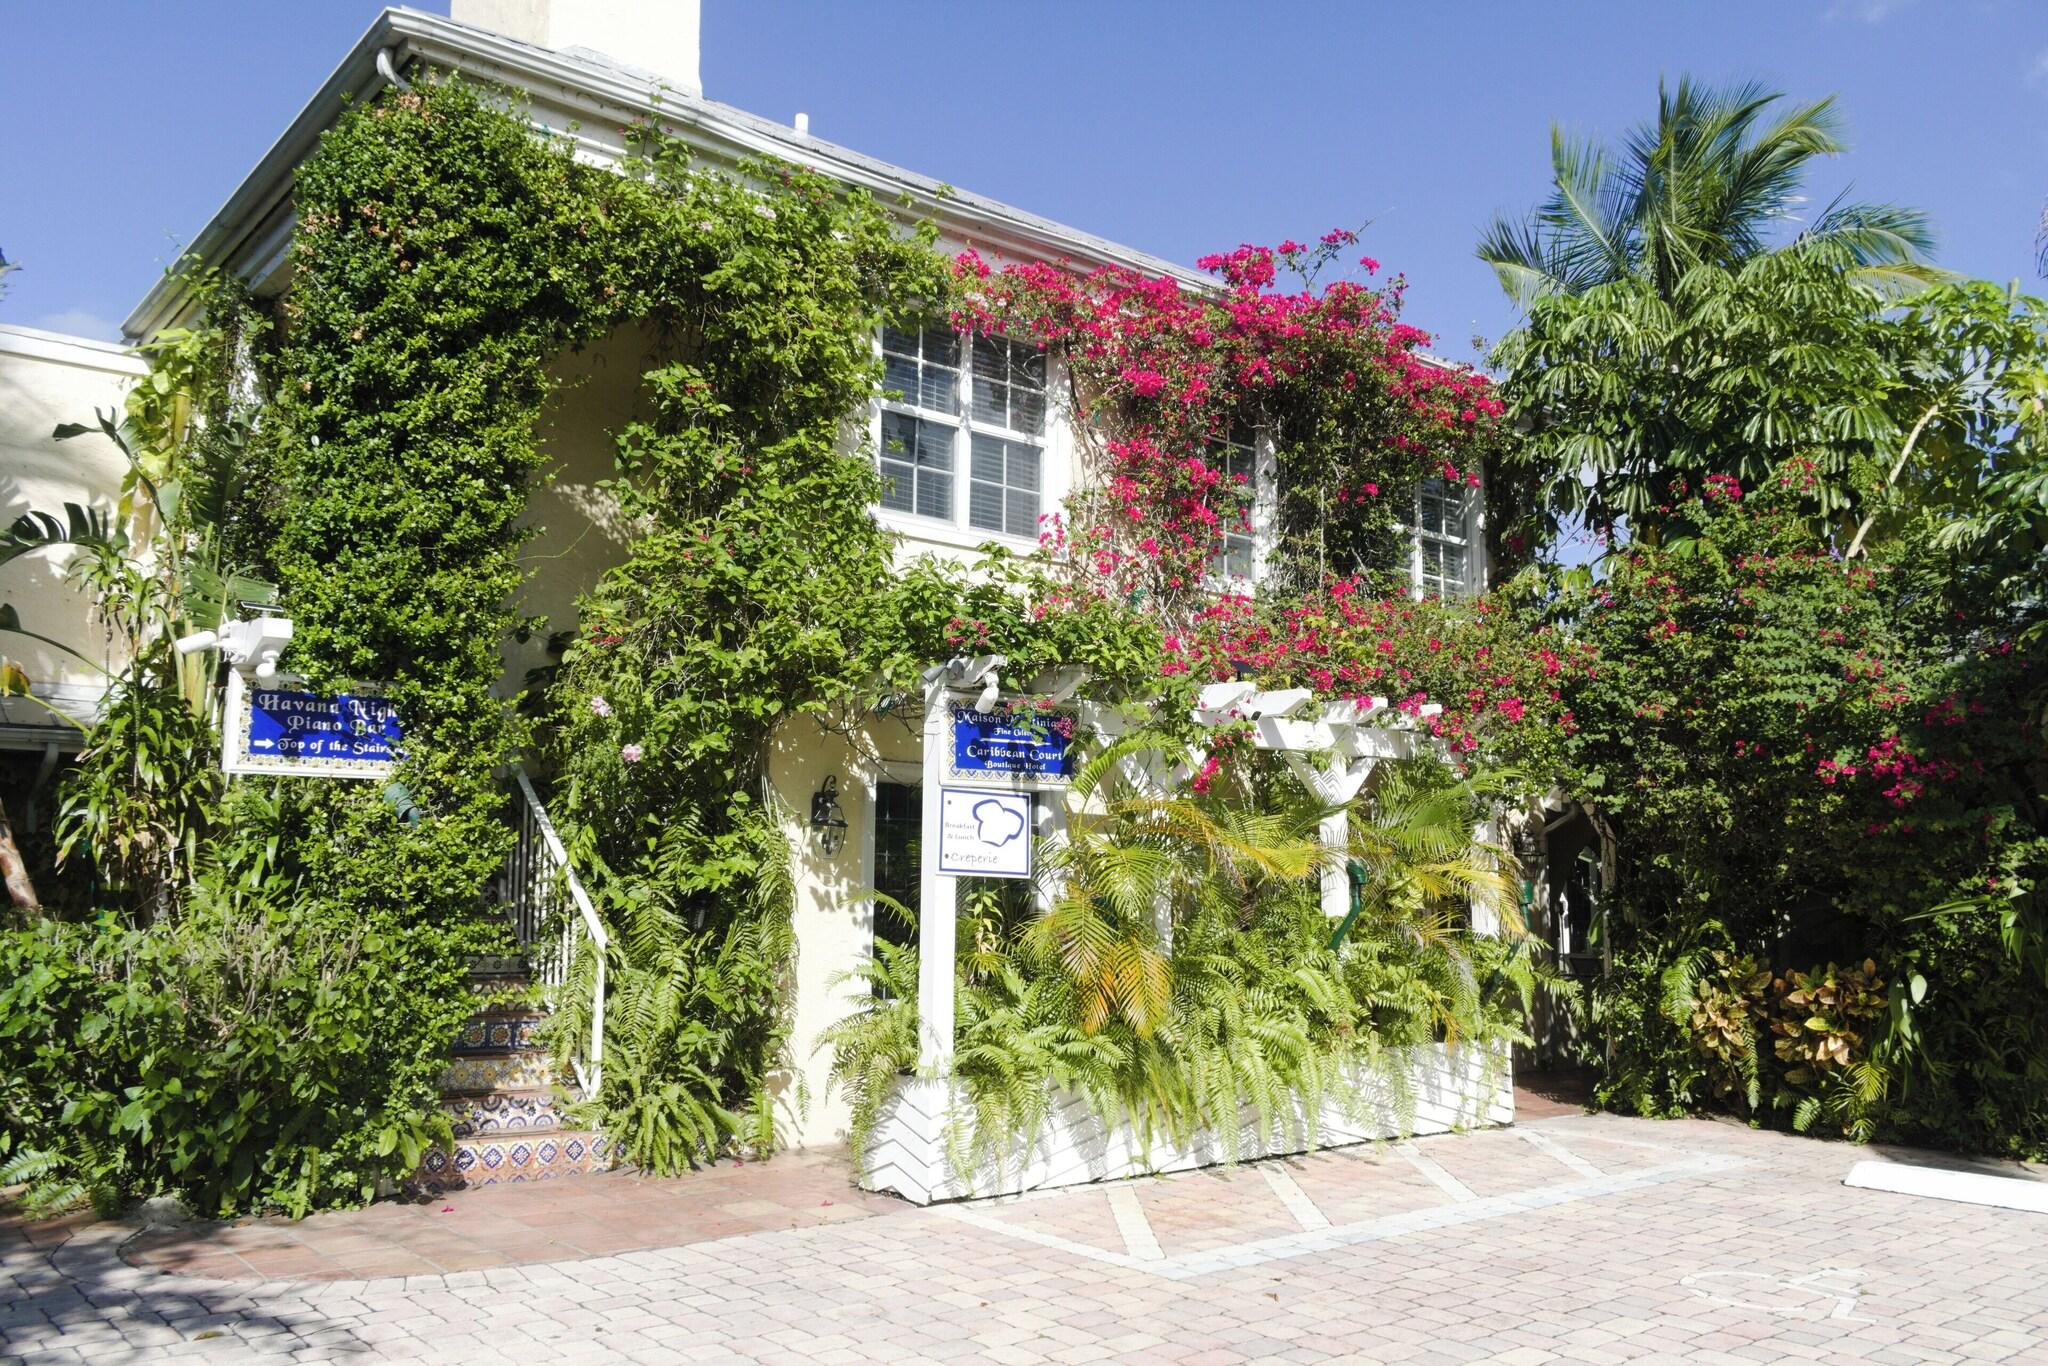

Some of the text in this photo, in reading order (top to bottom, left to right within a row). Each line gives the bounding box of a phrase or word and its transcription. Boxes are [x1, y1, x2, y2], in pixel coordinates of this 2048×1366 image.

[258, 694, 340, 715] Havana
[957, 711, 1001, 724] Maison
[287, 715, 386, 736] Piano Bar
[994, 727, 1011, 736] Fine
[278, 738, 305, 752] Top
[309, 739, 324, 753] of
[329, 740, 348, 751] the
[966, 745, 1062, 761] Caribbean Court
[984, 760, 1046, 770] Boutique Hotel
